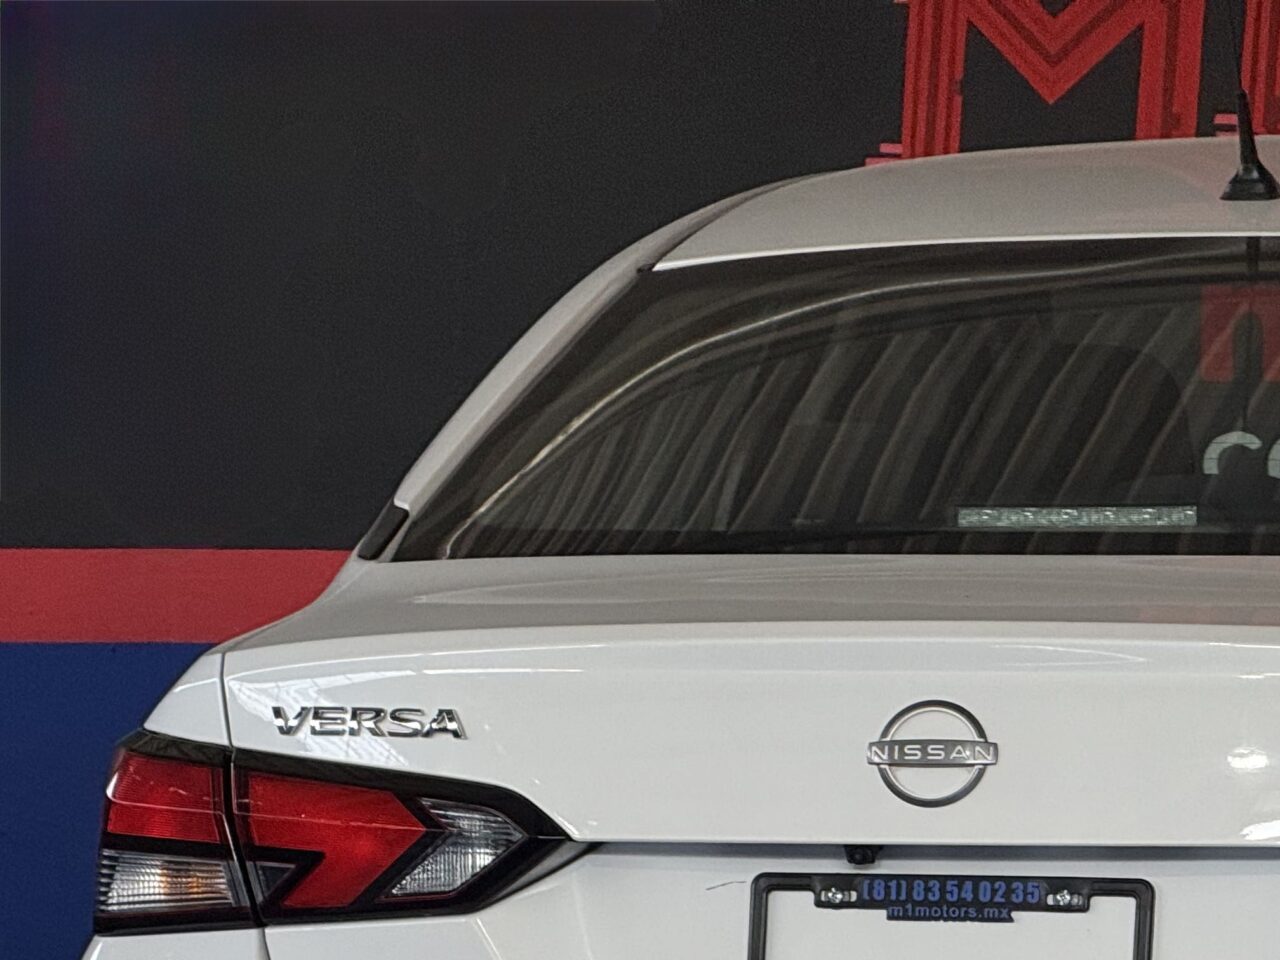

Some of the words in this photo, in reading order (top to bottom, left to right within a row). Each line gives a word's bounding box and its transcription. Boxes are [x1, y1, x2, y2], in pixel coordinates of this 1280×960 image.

[271, 706, 468, 740] VERSA
[870, 744, 994, 762] NISSAN
[888, 903, 1009, 918] m1motors.mx
